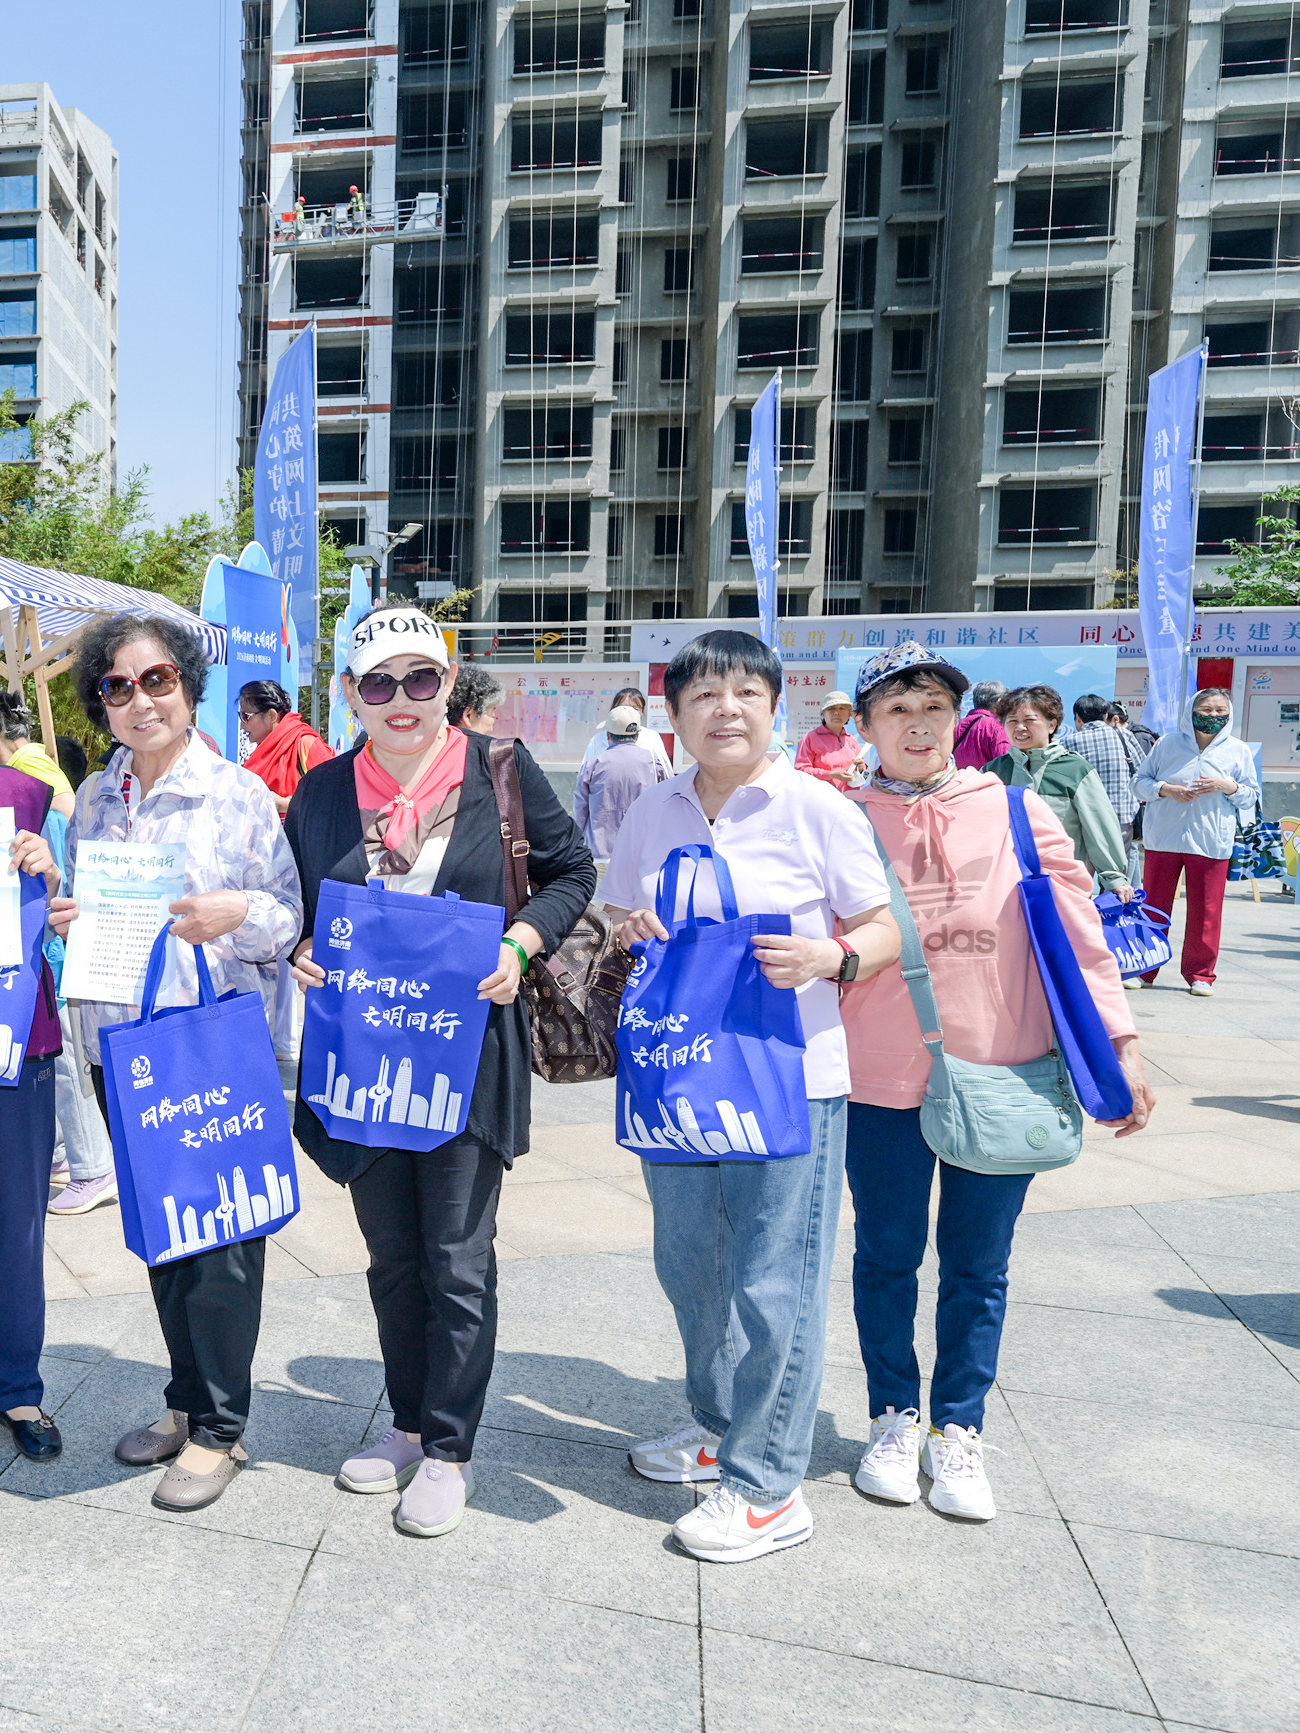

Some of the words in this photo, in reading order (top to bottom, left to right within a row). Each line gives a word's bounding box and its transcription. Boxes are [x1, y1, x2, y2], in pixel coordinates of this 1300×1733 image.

[354, 617, 440, 649] SPORT
[751, 626, 1040, 648] 策群力创造和谐社区
[1080, 621, 1300, 644] 同心共建美
[799, 650, 818, 658] and
[1119, 646, 1143, 654] One
[1215, 645, 1241, 653] One
[1246, 644, 1279, 653] Mind
[1285, 645, 1297, 653] to
[517, 677, 570, 687] 公示栏
[787, 675, 827, 687] 好生活
[917, 923, 996, 953] das
[327, 968, 430, 999] 网络同心
[361, 1004, 463, 1040] 文明同行
[631, 1033, 714, 1070] 文明同行
[140, 1085, 231, 1129] 网络同心
[179, 1102, 266, 1149] 文明同行
